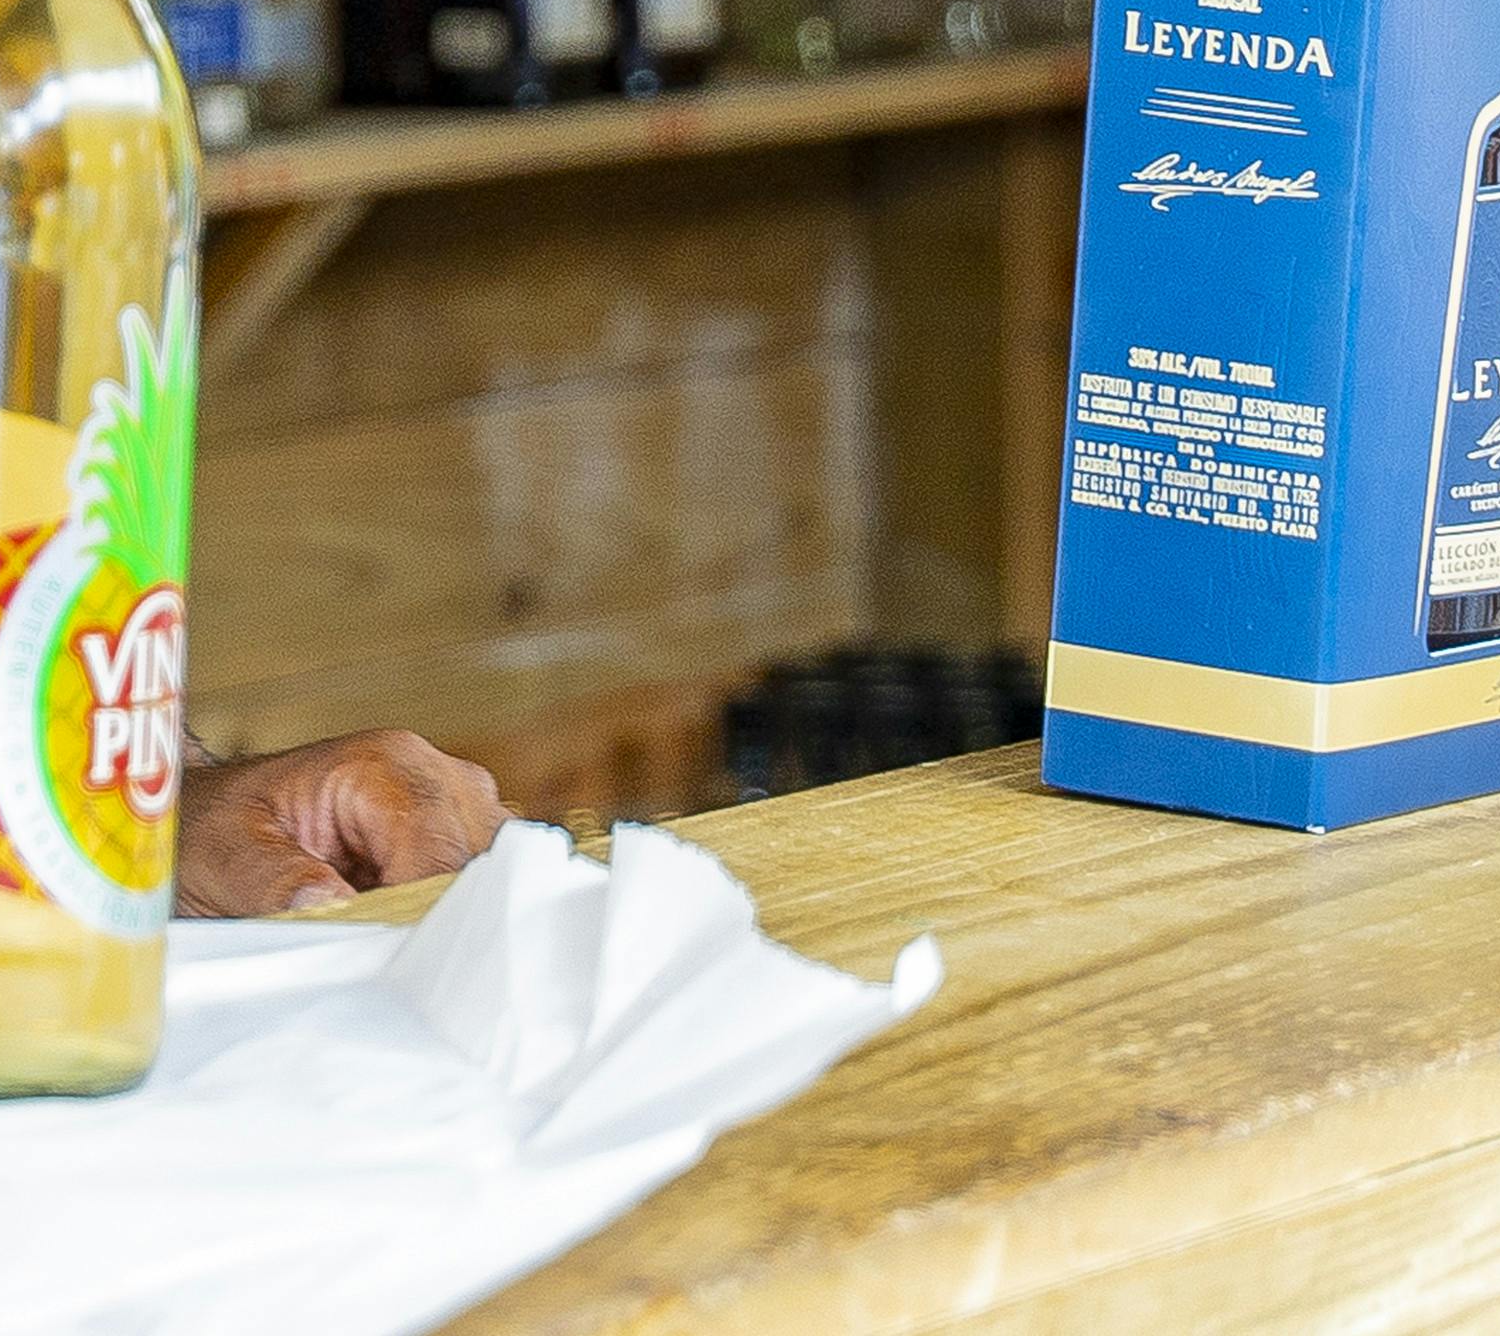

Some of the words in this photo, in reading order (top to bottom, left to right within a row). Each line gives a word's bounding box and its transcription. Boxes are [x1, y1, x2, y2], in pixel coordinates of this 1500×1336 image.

[1124, 10, 1334, 77] LEYENDA
[1080, 373, 1133, 399] DISFRUTA
[1137, 381, 1154, 401] DE
[1241, 397, 1327, 427] RESPONSABLE
[1072, 472, 1141, 498] REGISTRO
[1150, 485, 1228, 511] SANITARIO
[1237, 498, 1262, 516] NO.
[1190, 458, 1321, 490] DOMINICANA
[1071, 488, 1125, 511] BRUGAL
[1213, 512, 1268, 532] PUERTO
[1271, 521, 1319, 540] PLATA
[80, 590, 181, 706] VIN
